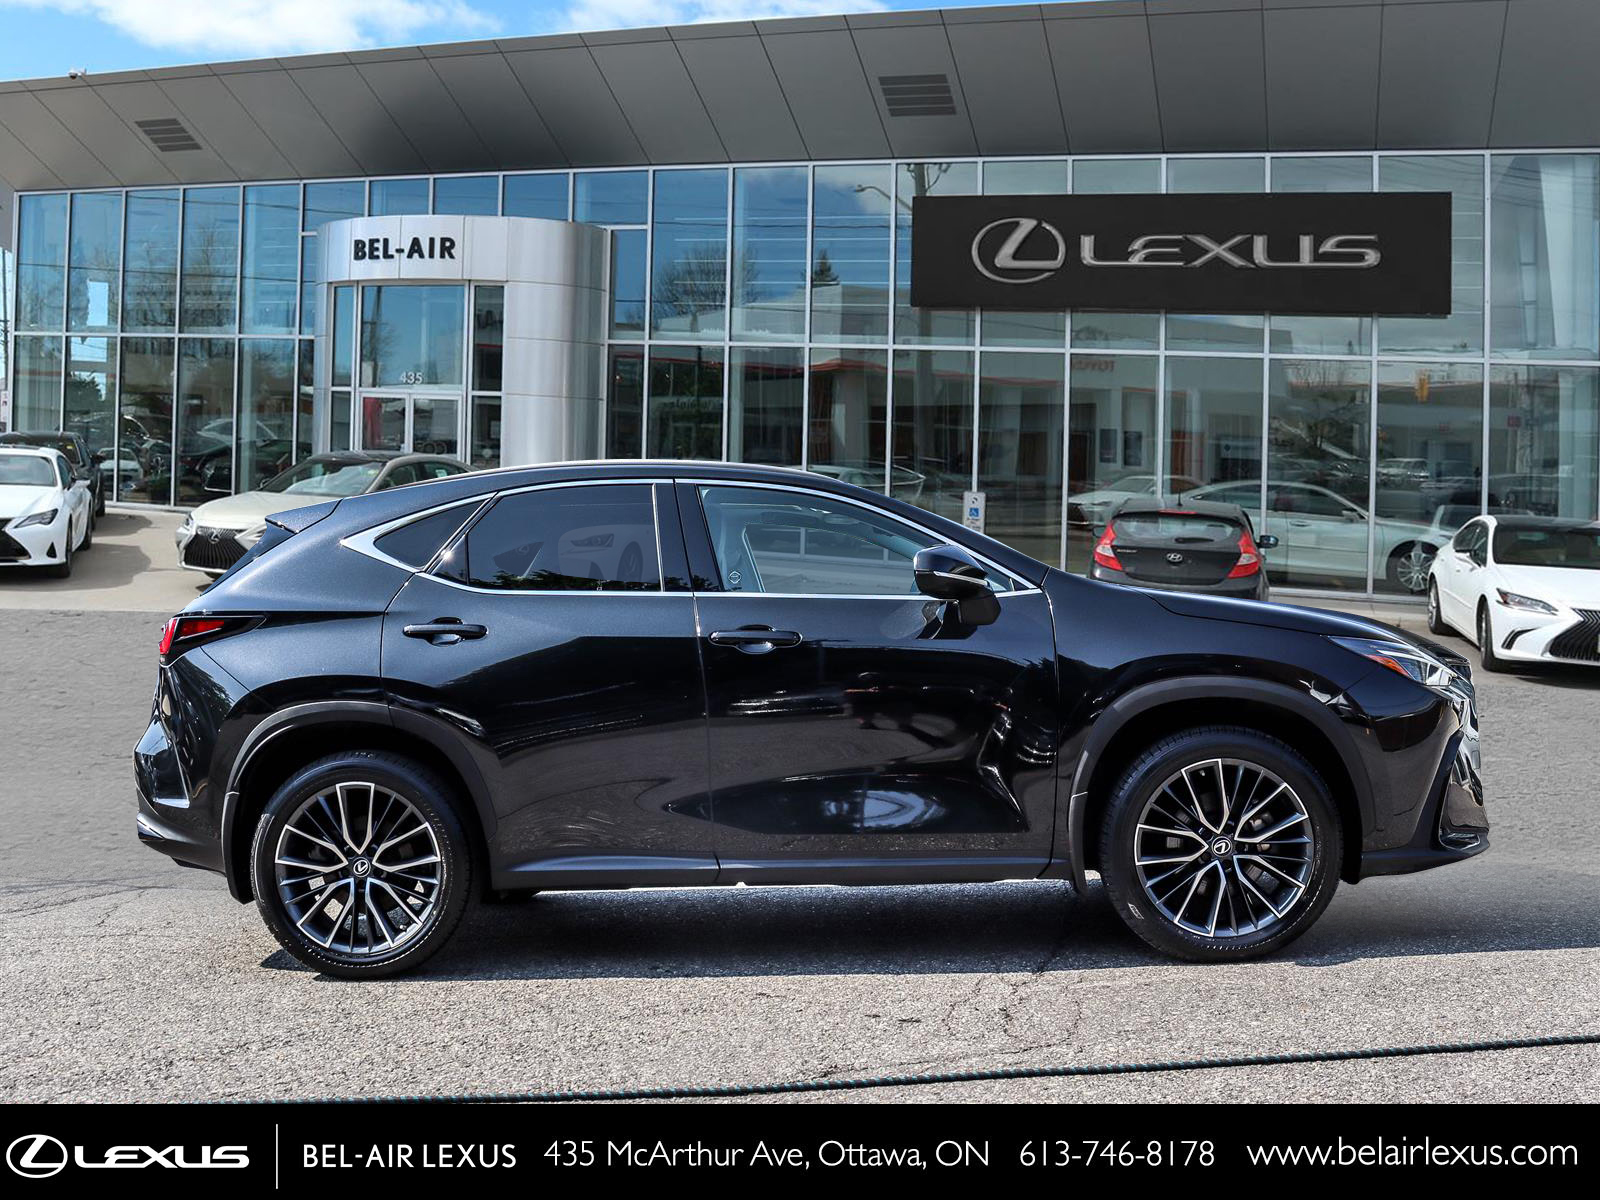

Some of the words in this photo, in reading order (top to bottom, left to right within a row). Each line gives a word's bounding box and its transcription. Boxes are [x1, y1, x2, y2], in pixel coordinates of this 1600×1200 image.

[353, 237, 456, 261] BEL-AIR
[1080, 234, 1381, 268] LEXUS
[399, 372, 423, 384] 435
